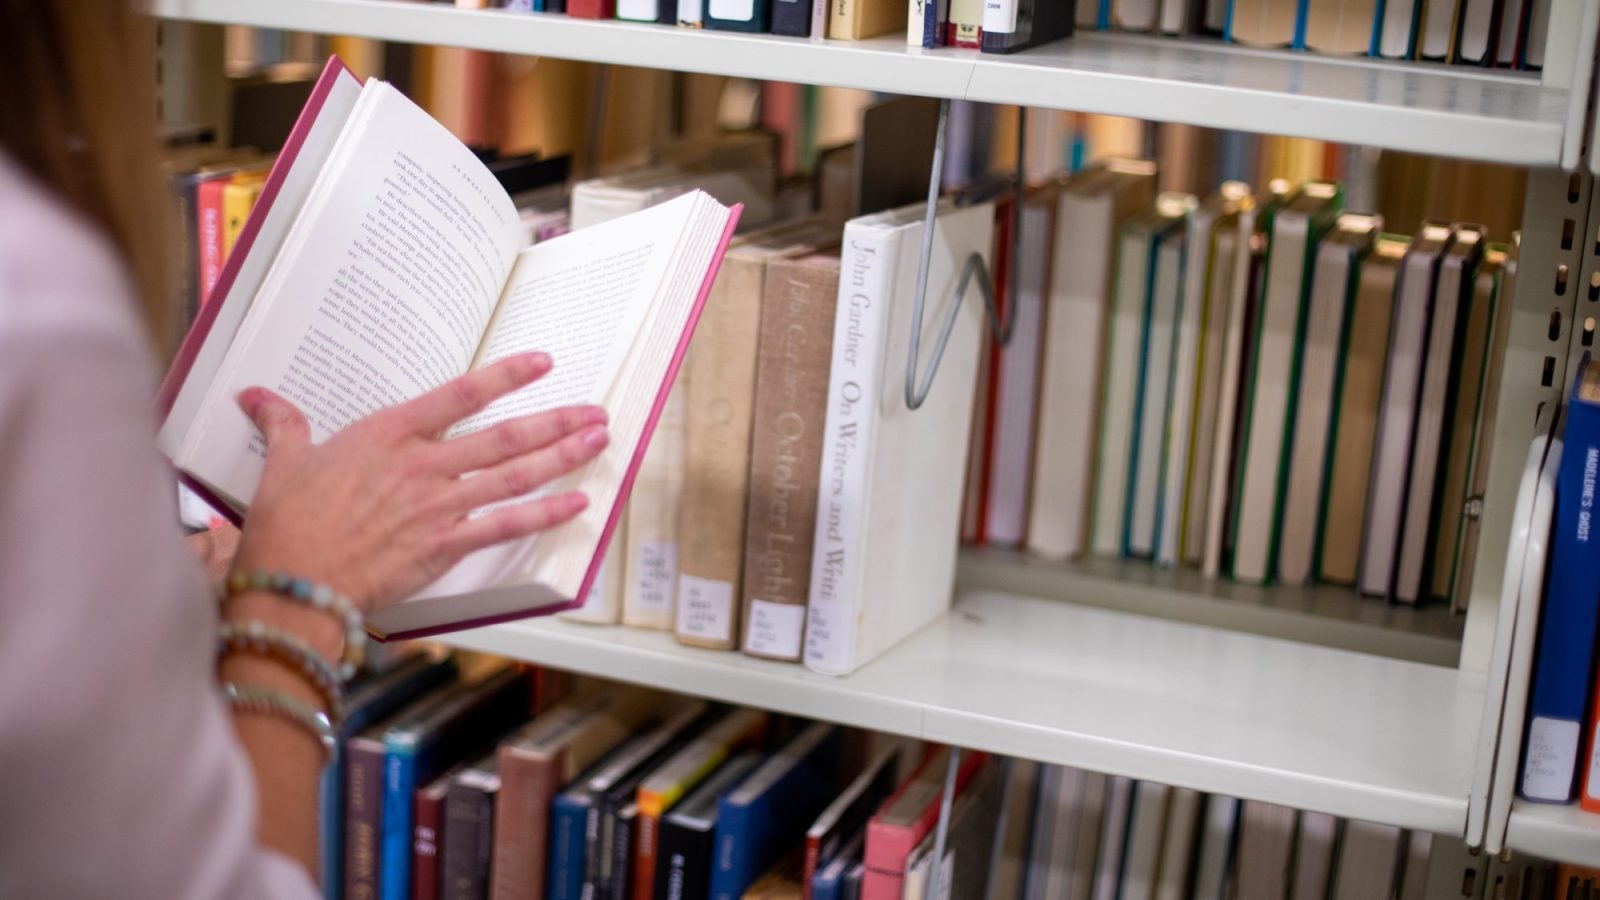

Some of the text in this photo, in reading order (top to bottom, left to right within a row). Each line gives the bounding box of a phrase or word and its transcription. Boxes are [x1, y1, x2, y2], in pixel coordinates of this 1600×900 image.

[852, 240, 876, 287] John
[844, 293, 870, 366] Gardner
[839, 381, 862, 416] On
[770, 411, 805, 528] October
[830, 421, 857, 496] Writers
[825, 501, 843, 541] and
[1576, 448, 1599, 541] MADELEINE'S GHOST
[819, 548, 845, 601] Writi
